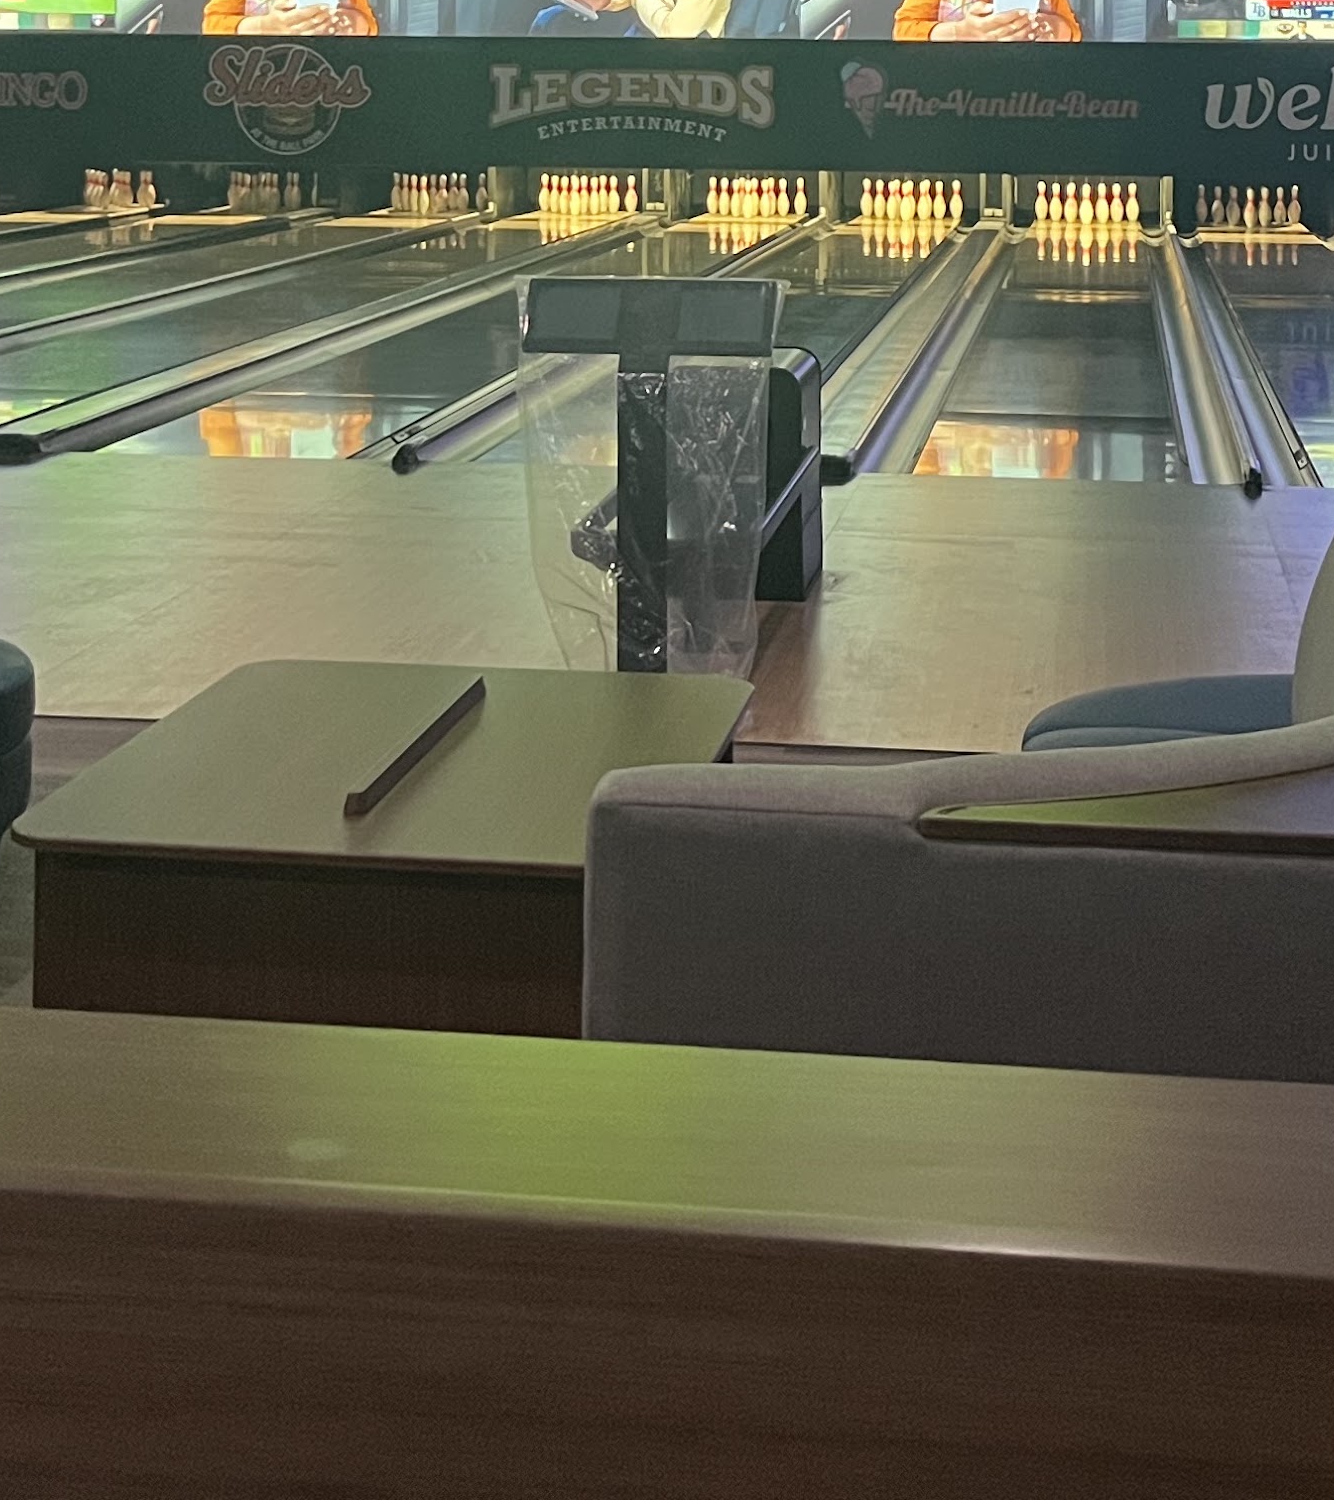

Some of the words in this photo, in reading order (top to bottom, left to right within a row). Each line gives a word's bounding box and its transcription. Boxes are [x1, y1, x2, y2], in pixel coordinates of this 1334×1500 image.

[203, 44, 371, 108] Sliders
[489, 63, 775, 129] LEGENDS
[1060, 90, 1140, 119] Bean
[537, 115, 727, 142] ENTERTAINMENT
